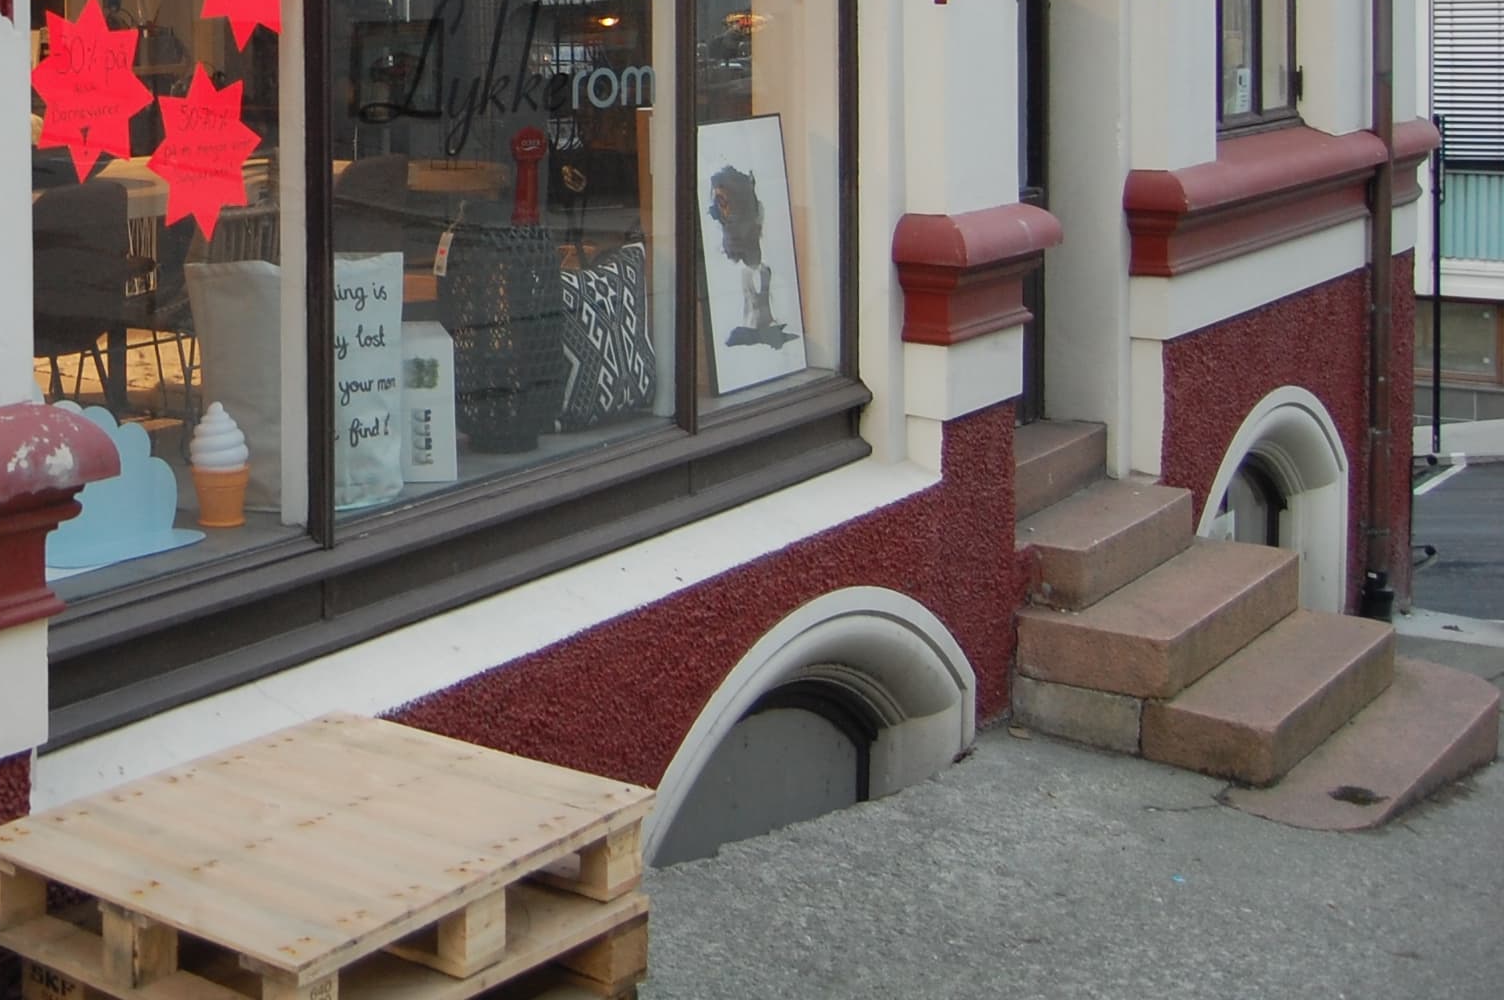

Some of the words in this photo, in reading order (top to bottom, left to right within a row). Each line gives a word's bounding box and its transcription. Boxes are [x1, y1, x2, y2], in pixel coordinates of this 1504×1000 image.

[372, 281, 388, 302] is
[355, 323, 386, 348] lost
[338, 377, 374, 407] your
